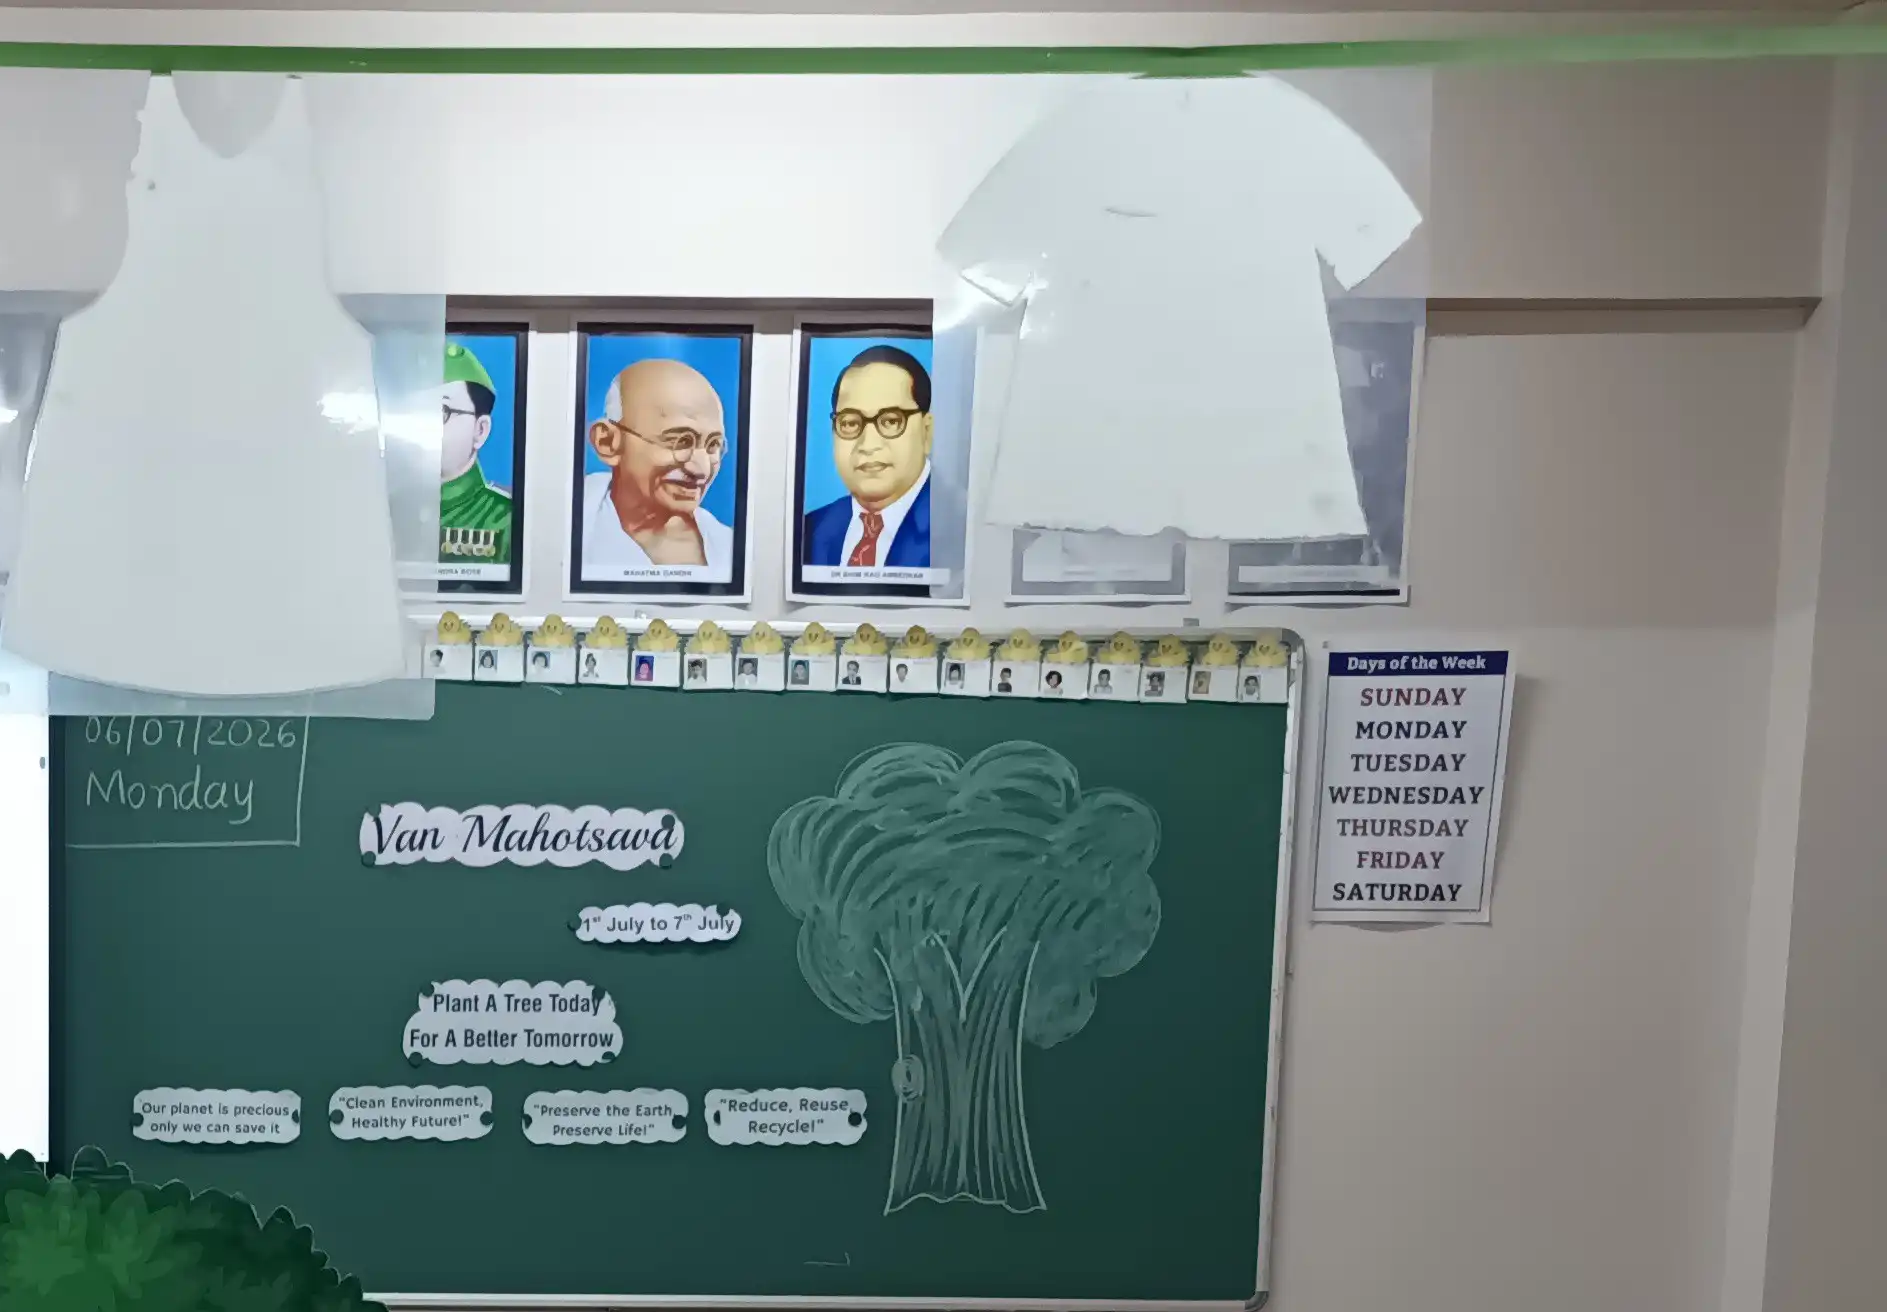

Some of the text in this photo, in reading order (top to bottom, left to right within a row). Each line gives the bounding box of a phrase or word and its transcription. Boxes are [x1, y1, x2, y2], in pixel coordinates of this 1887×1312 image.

[1348, 655, 1486, 674] Days of the Week
[1360, 687, 1466, 707] SUNDAY
[85, 716, 296, 755] 06/07/2026
[1355, 720, 1468, 740] MONDAY
[1350, 753, 1466, 772] TUESDAY
[86, 764, 254, 824] Monday
[1328, 786, 1484, 805] WEDNESDAY
[373, 812, 678, 854] Van Mahotsava
[1336, 818, 1469, 837] THURSDAY
[1356, 850, 1445, 870] FRIDAY
[1332, 882, 1462, 901] SATURDAY
[606, 917, 644, 934] July
[650, 918, 668, 931] to
[698, 916, 734, 934] July
[433, 994, 600, 1016] Plant A Tree Today
[410, 1029, 614, 1048] For A Better Tomorrow
[142, 1103, 289, 1119] Our planet is precious
[339, 1095, 484, 1110] "Clean Environment,
[534, 1104, 600, 1117] "Preserve
[605, 1105, 631, 1116] the
[720, 1098, 793, 1114] "Reduce,
[150, 1122, 280, 1136] only we can save it
[352, 1116, 406, 1131] Healthy
[553, 1124, 613, 1136] Preserve
